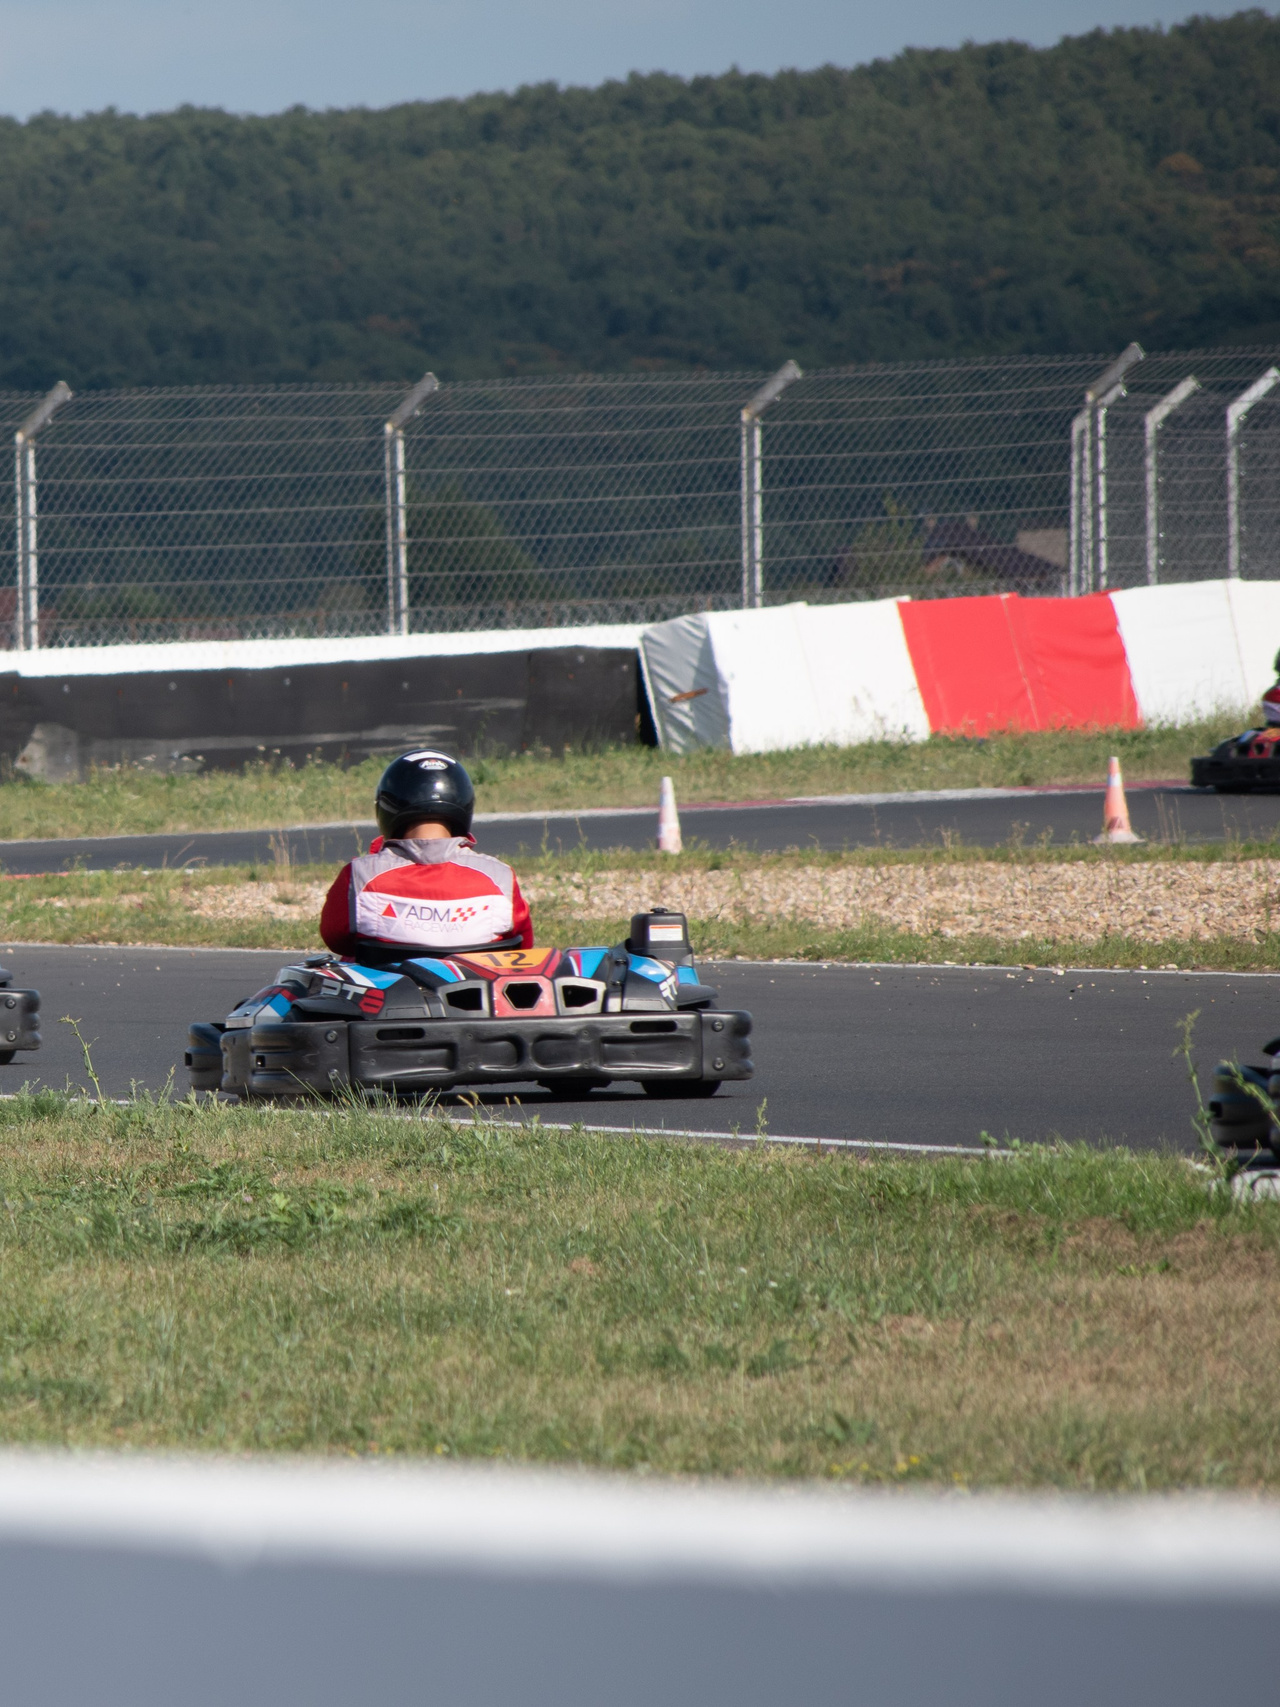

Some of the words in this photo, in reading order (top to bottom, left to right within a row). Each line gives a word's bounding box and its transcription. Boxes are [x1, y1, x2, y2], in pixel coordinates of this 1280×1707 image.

[405, 905, 451, 922] ADM
[404, 920, 465, 933] RACEWAY
[481, 952, 534, 967] 12
